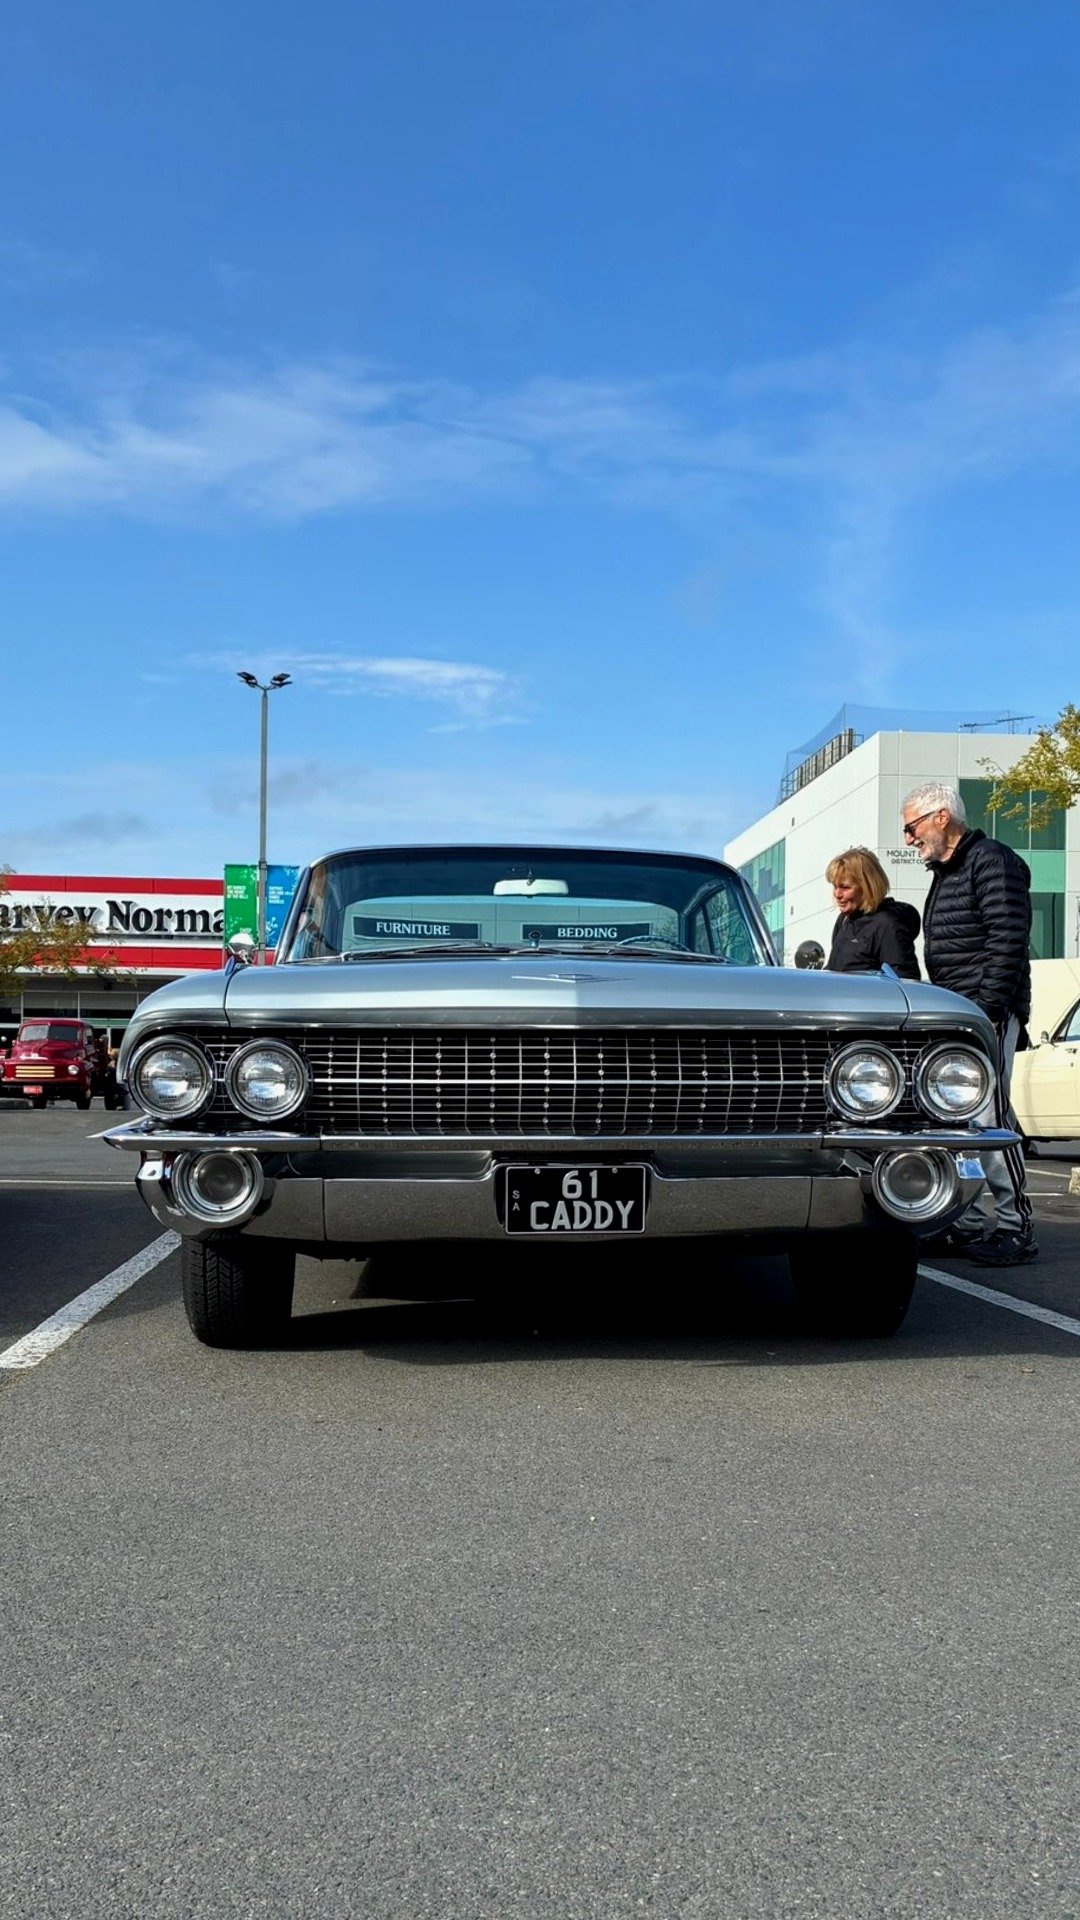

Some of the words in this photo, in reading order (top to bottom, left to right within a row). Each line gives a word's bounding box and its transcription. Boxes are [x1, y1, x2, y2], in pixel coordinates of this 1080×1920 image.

[0, 904, 97, 929] arvey
[106, 901, 224, 932] Norma
[376, 921, 451, 935] FURNITURE
[557, 927, 618, 938] BEDDING
[562, 1170, 599, 1199] 61
[530, 1200, 635, 1230] CADDY
